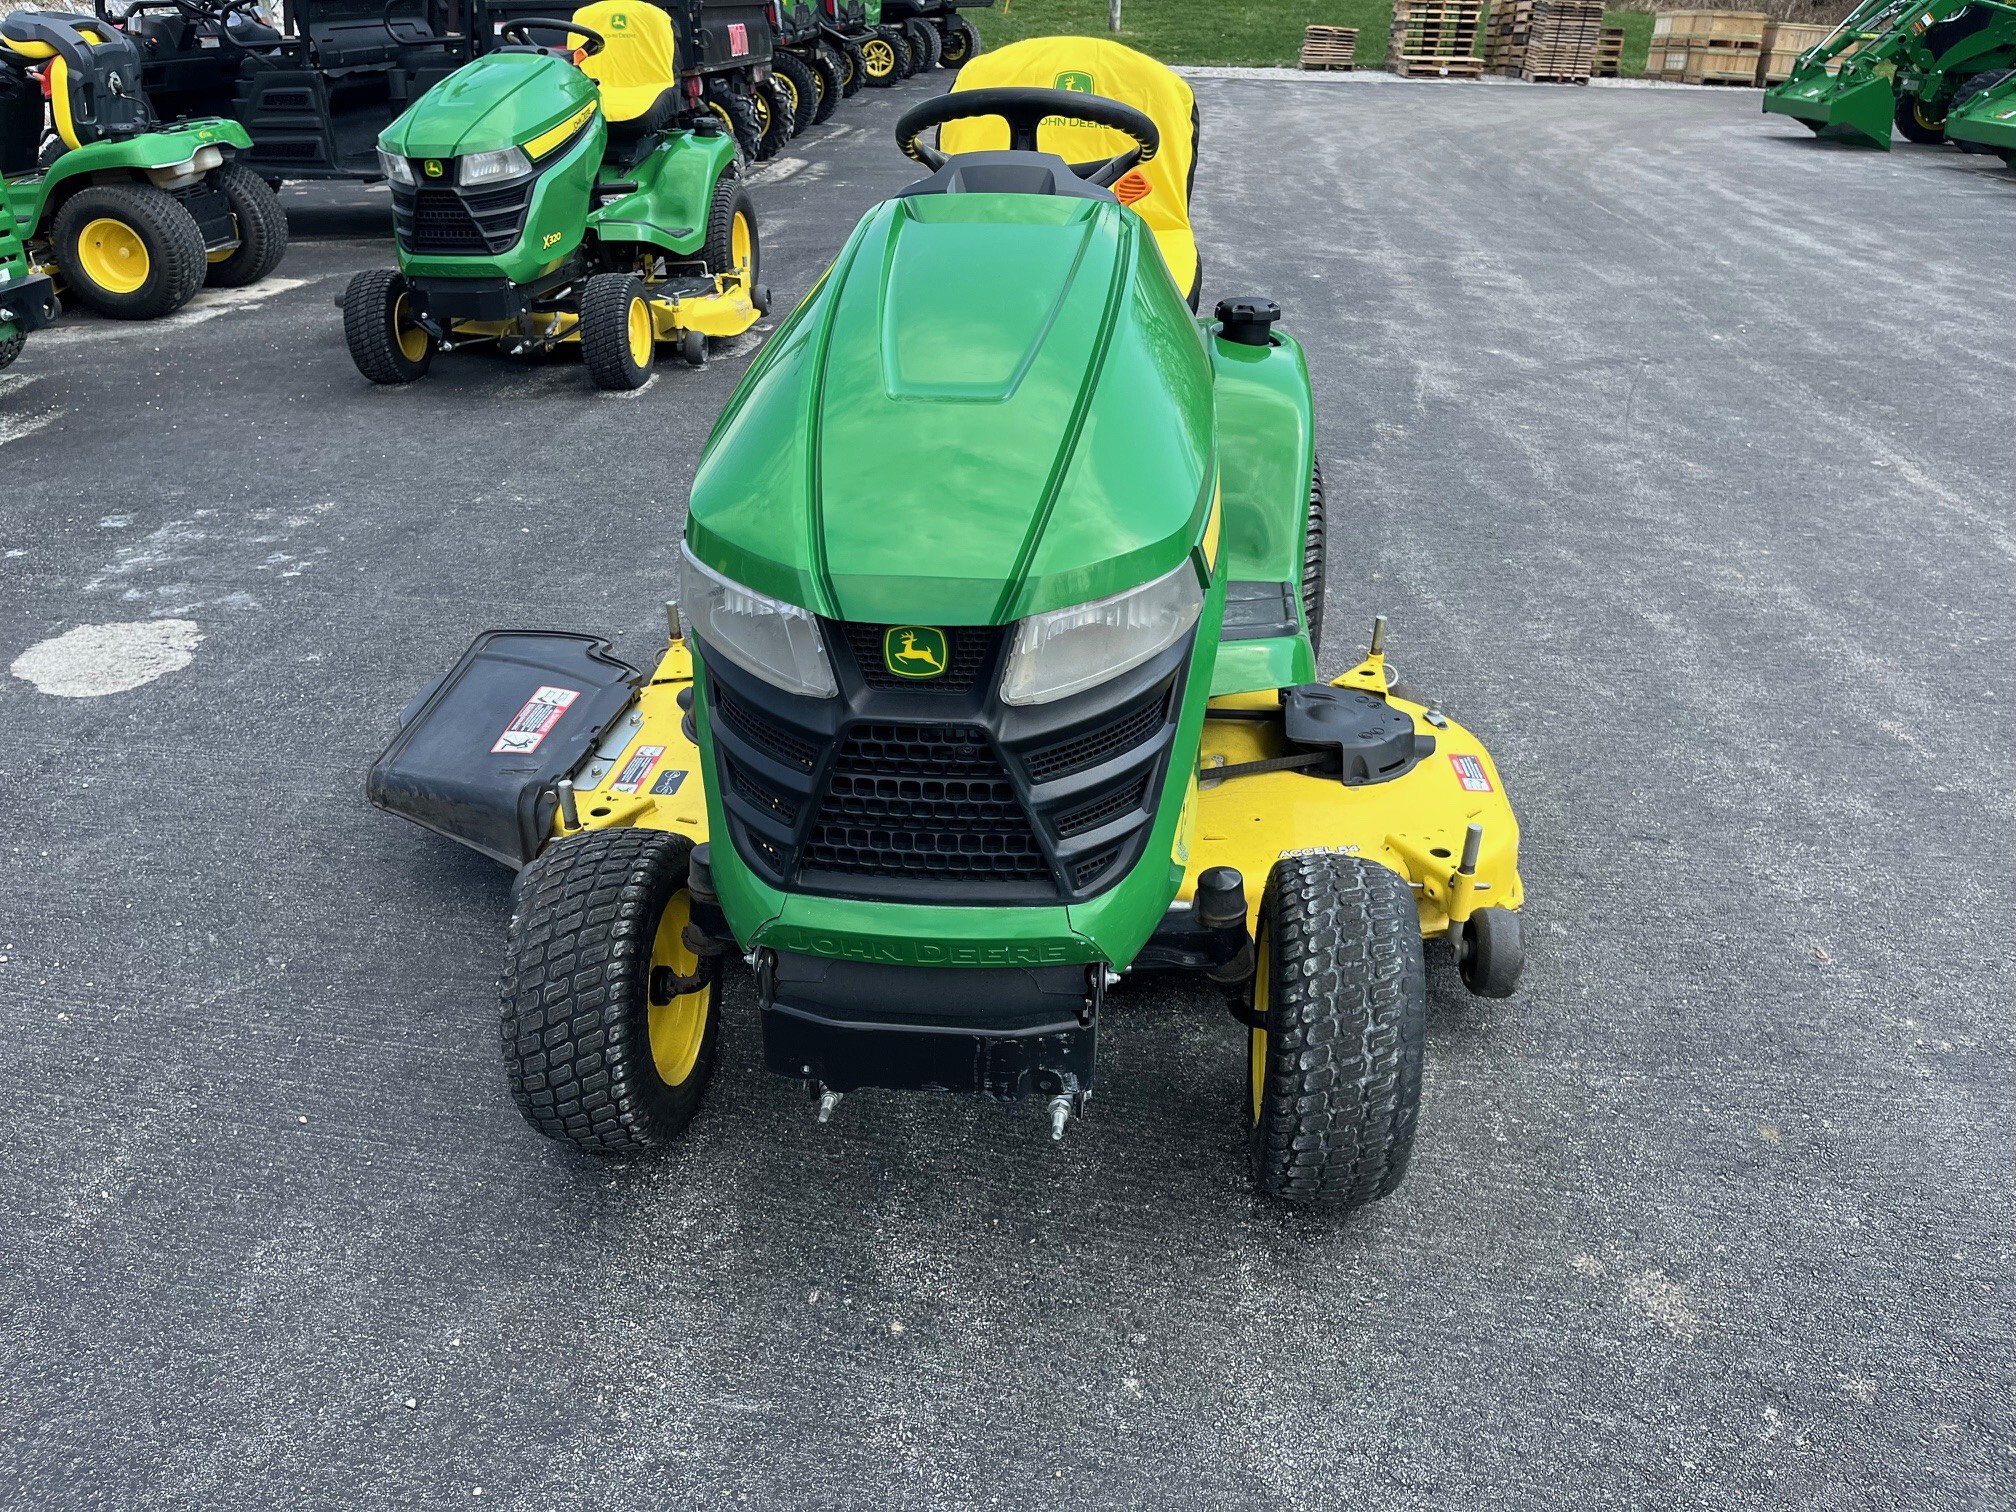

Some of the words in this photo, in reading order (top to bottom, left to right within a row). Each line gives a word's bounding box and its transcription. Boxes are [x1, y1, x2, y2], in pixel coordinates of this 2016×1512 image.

[1039, 117, 1066, 126] OHN
[787, 936, 904, 963] JOHN
[914, 940, 1067, 965] DEERE
